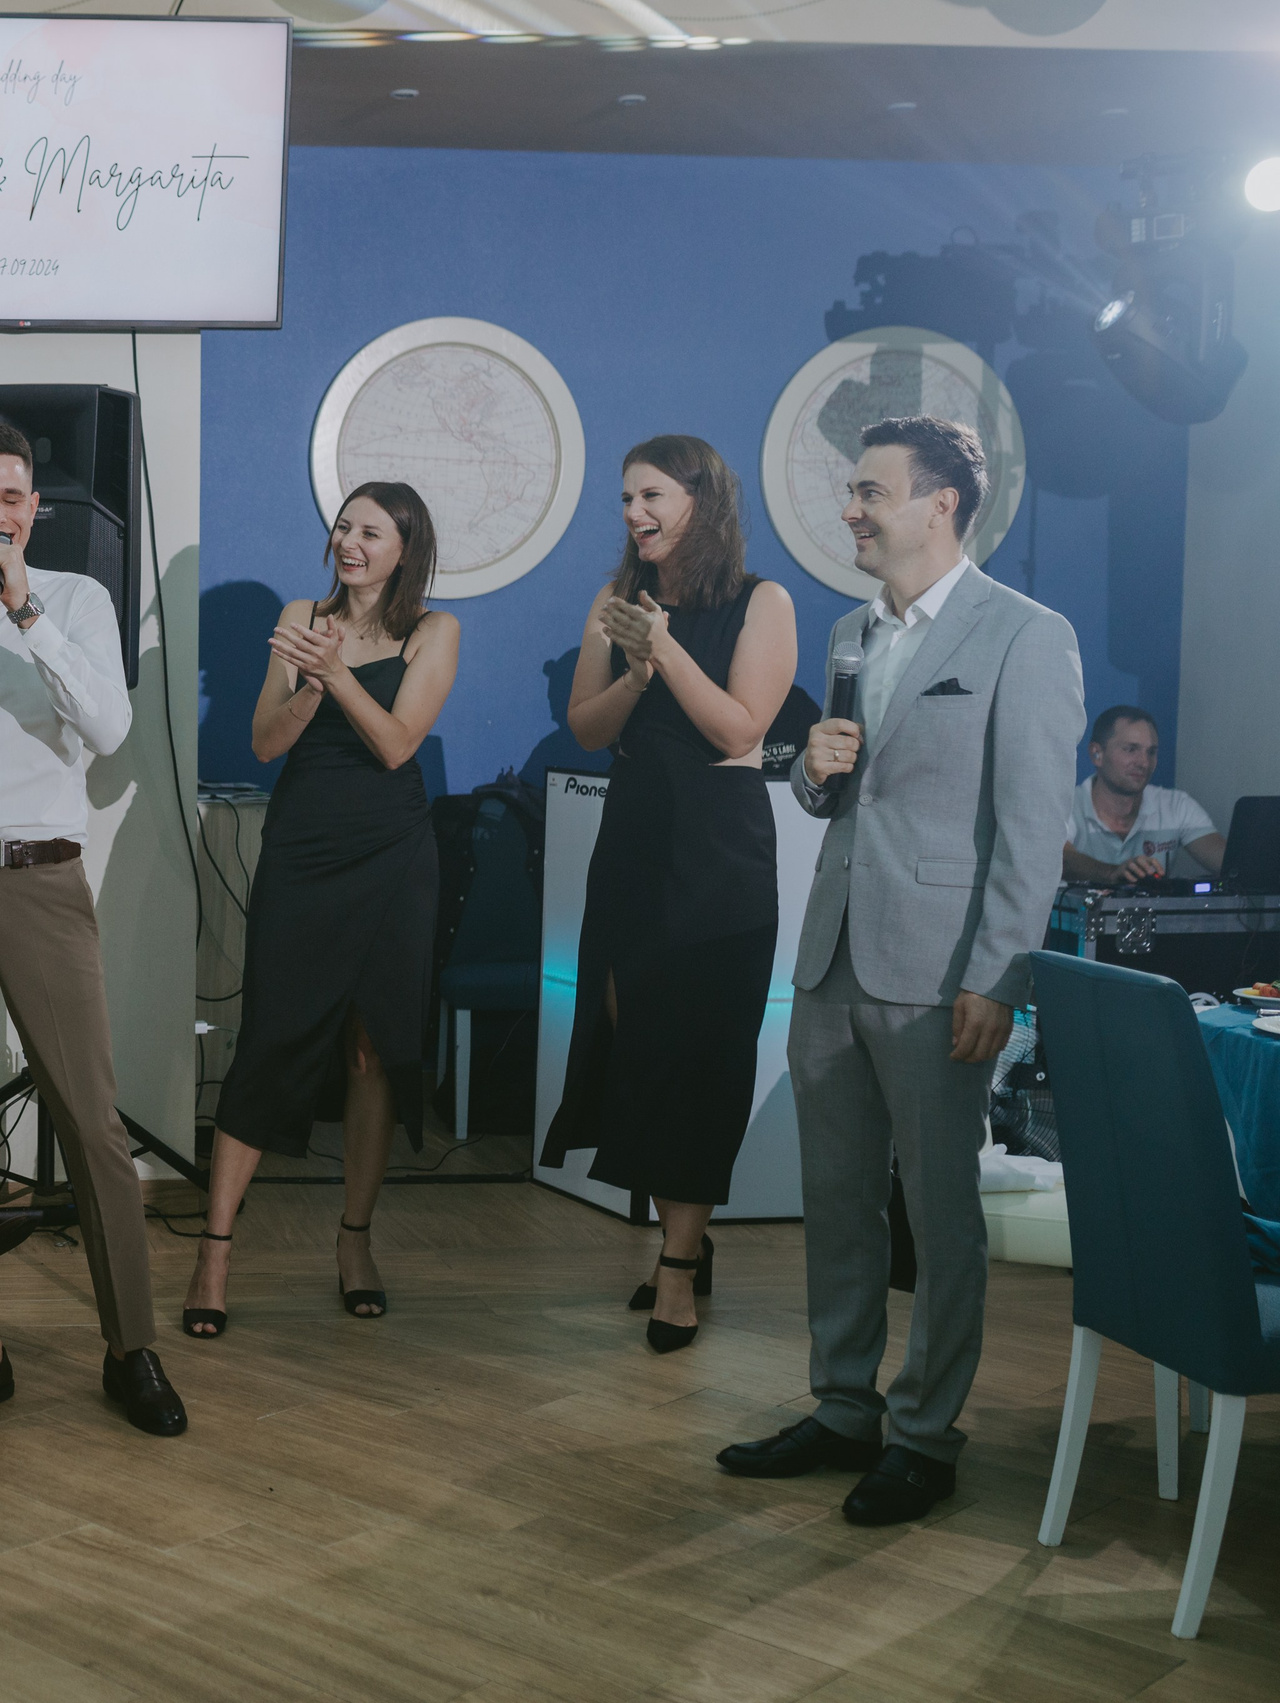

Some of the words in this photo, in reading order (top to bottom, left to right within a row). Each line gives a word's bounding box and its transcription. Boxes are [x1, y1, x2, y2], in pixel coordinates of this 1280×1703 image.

[51, 59, 82, 106] day
[25, 135, 249, 231] Margarita
[564, 776, 607, 798] Pione
